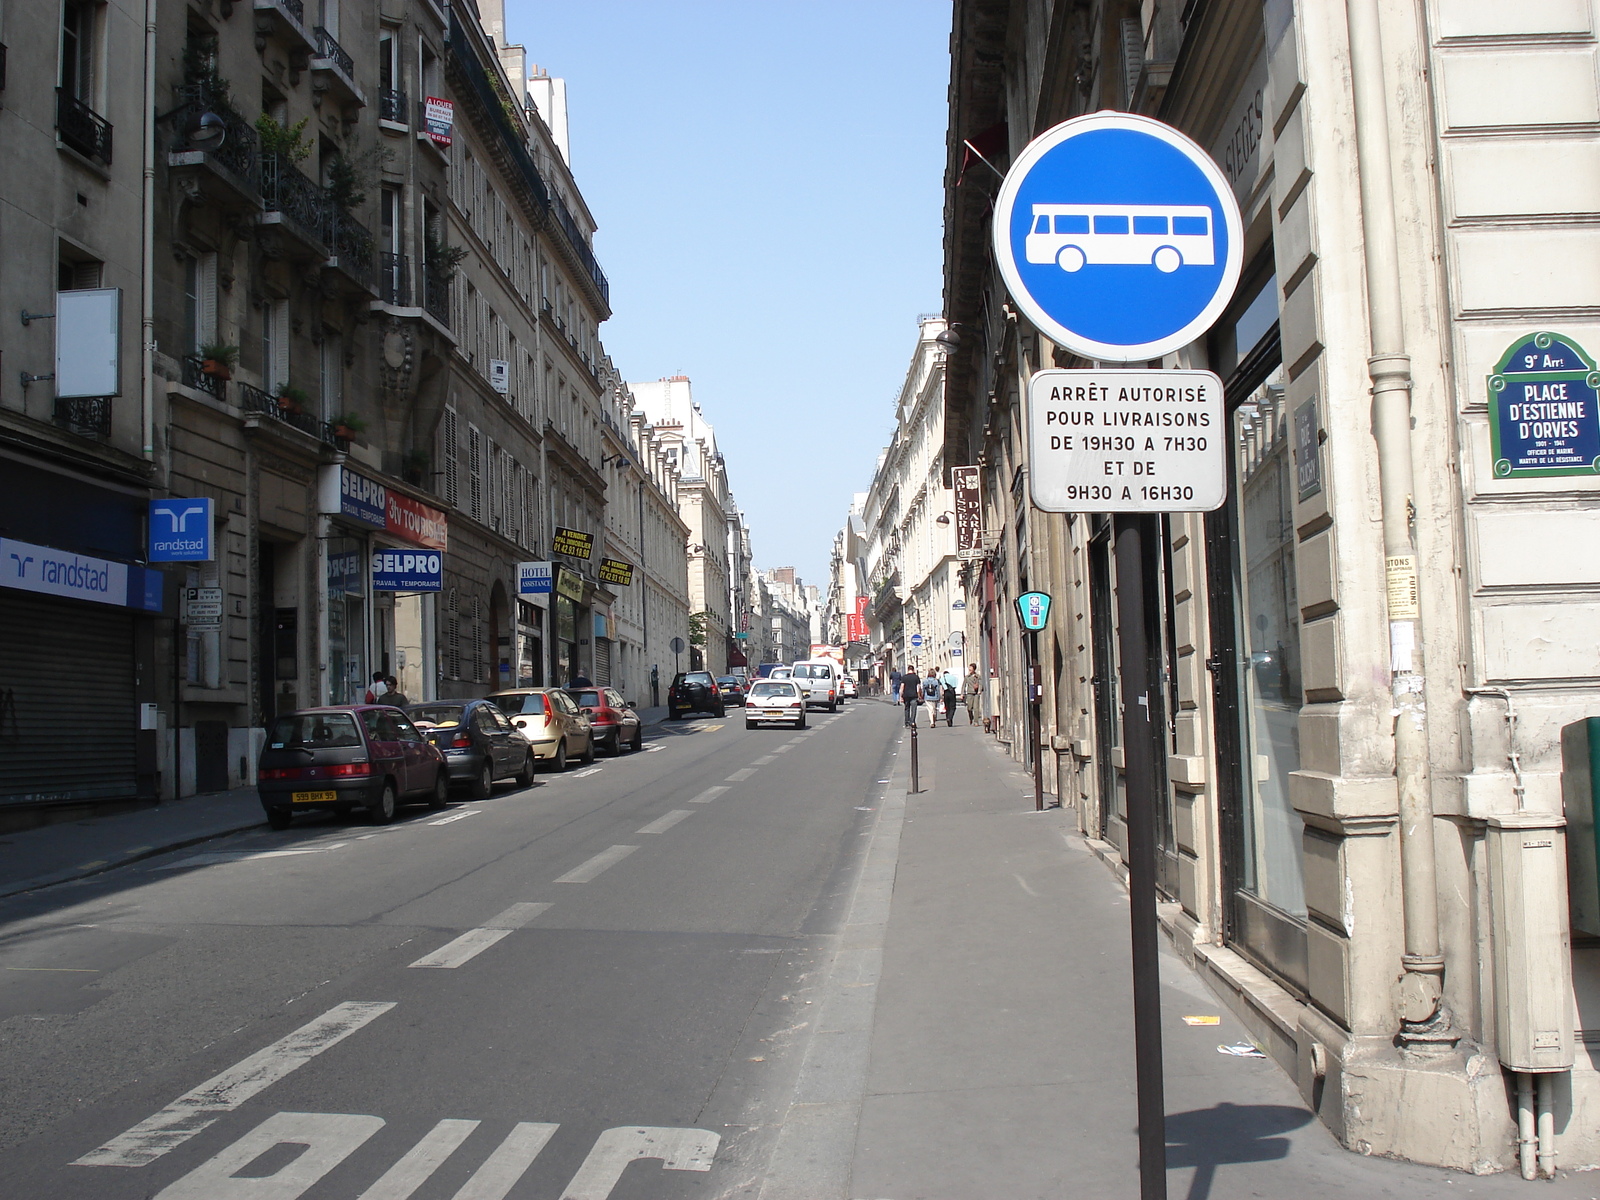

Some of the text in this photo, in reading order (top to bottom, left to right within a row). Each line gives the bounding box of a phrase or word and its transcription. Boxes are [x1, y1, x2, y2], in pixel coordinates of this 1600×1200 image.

[434, 99, 452, 110] LOUER
[1050, 382, 1207, 402] ARRÊT AUTORISÉ
[1524, 383, 1567, 402] PLACE
[1047, 411, 1210, 426] POUR LIVRAISONS
[1510, 402, 1585, 421] D'ESTIENNE
[1519, 421, 1578, 439] D'ORVES
[1051, 436, 1207, 451] DE 19H30 A 7H30
[1104, 461, 1156, 475] ET DE
[342, 469, 385, 510] SELPRO
[1067, 486, 1193, 500] 9H30 A 16H30
[343, 502, 385, 526] TRAVAIL TEMPORAIRE
[955, 470, 969, 549] TAPISSERIES
[404, 508, 445, 543] TOURISME
[154, 538, 203, 550] randstad
[568, 530, 588, 541] VENDRE
[373, 554, 439, 574] SELPRO
[522, 567, 550, 577] HOTEL
[611, 561, 628, 570] VENDRE
[42, 557, 108, 592] randstad
[1409, 575, 1417, 606] FUTONS
